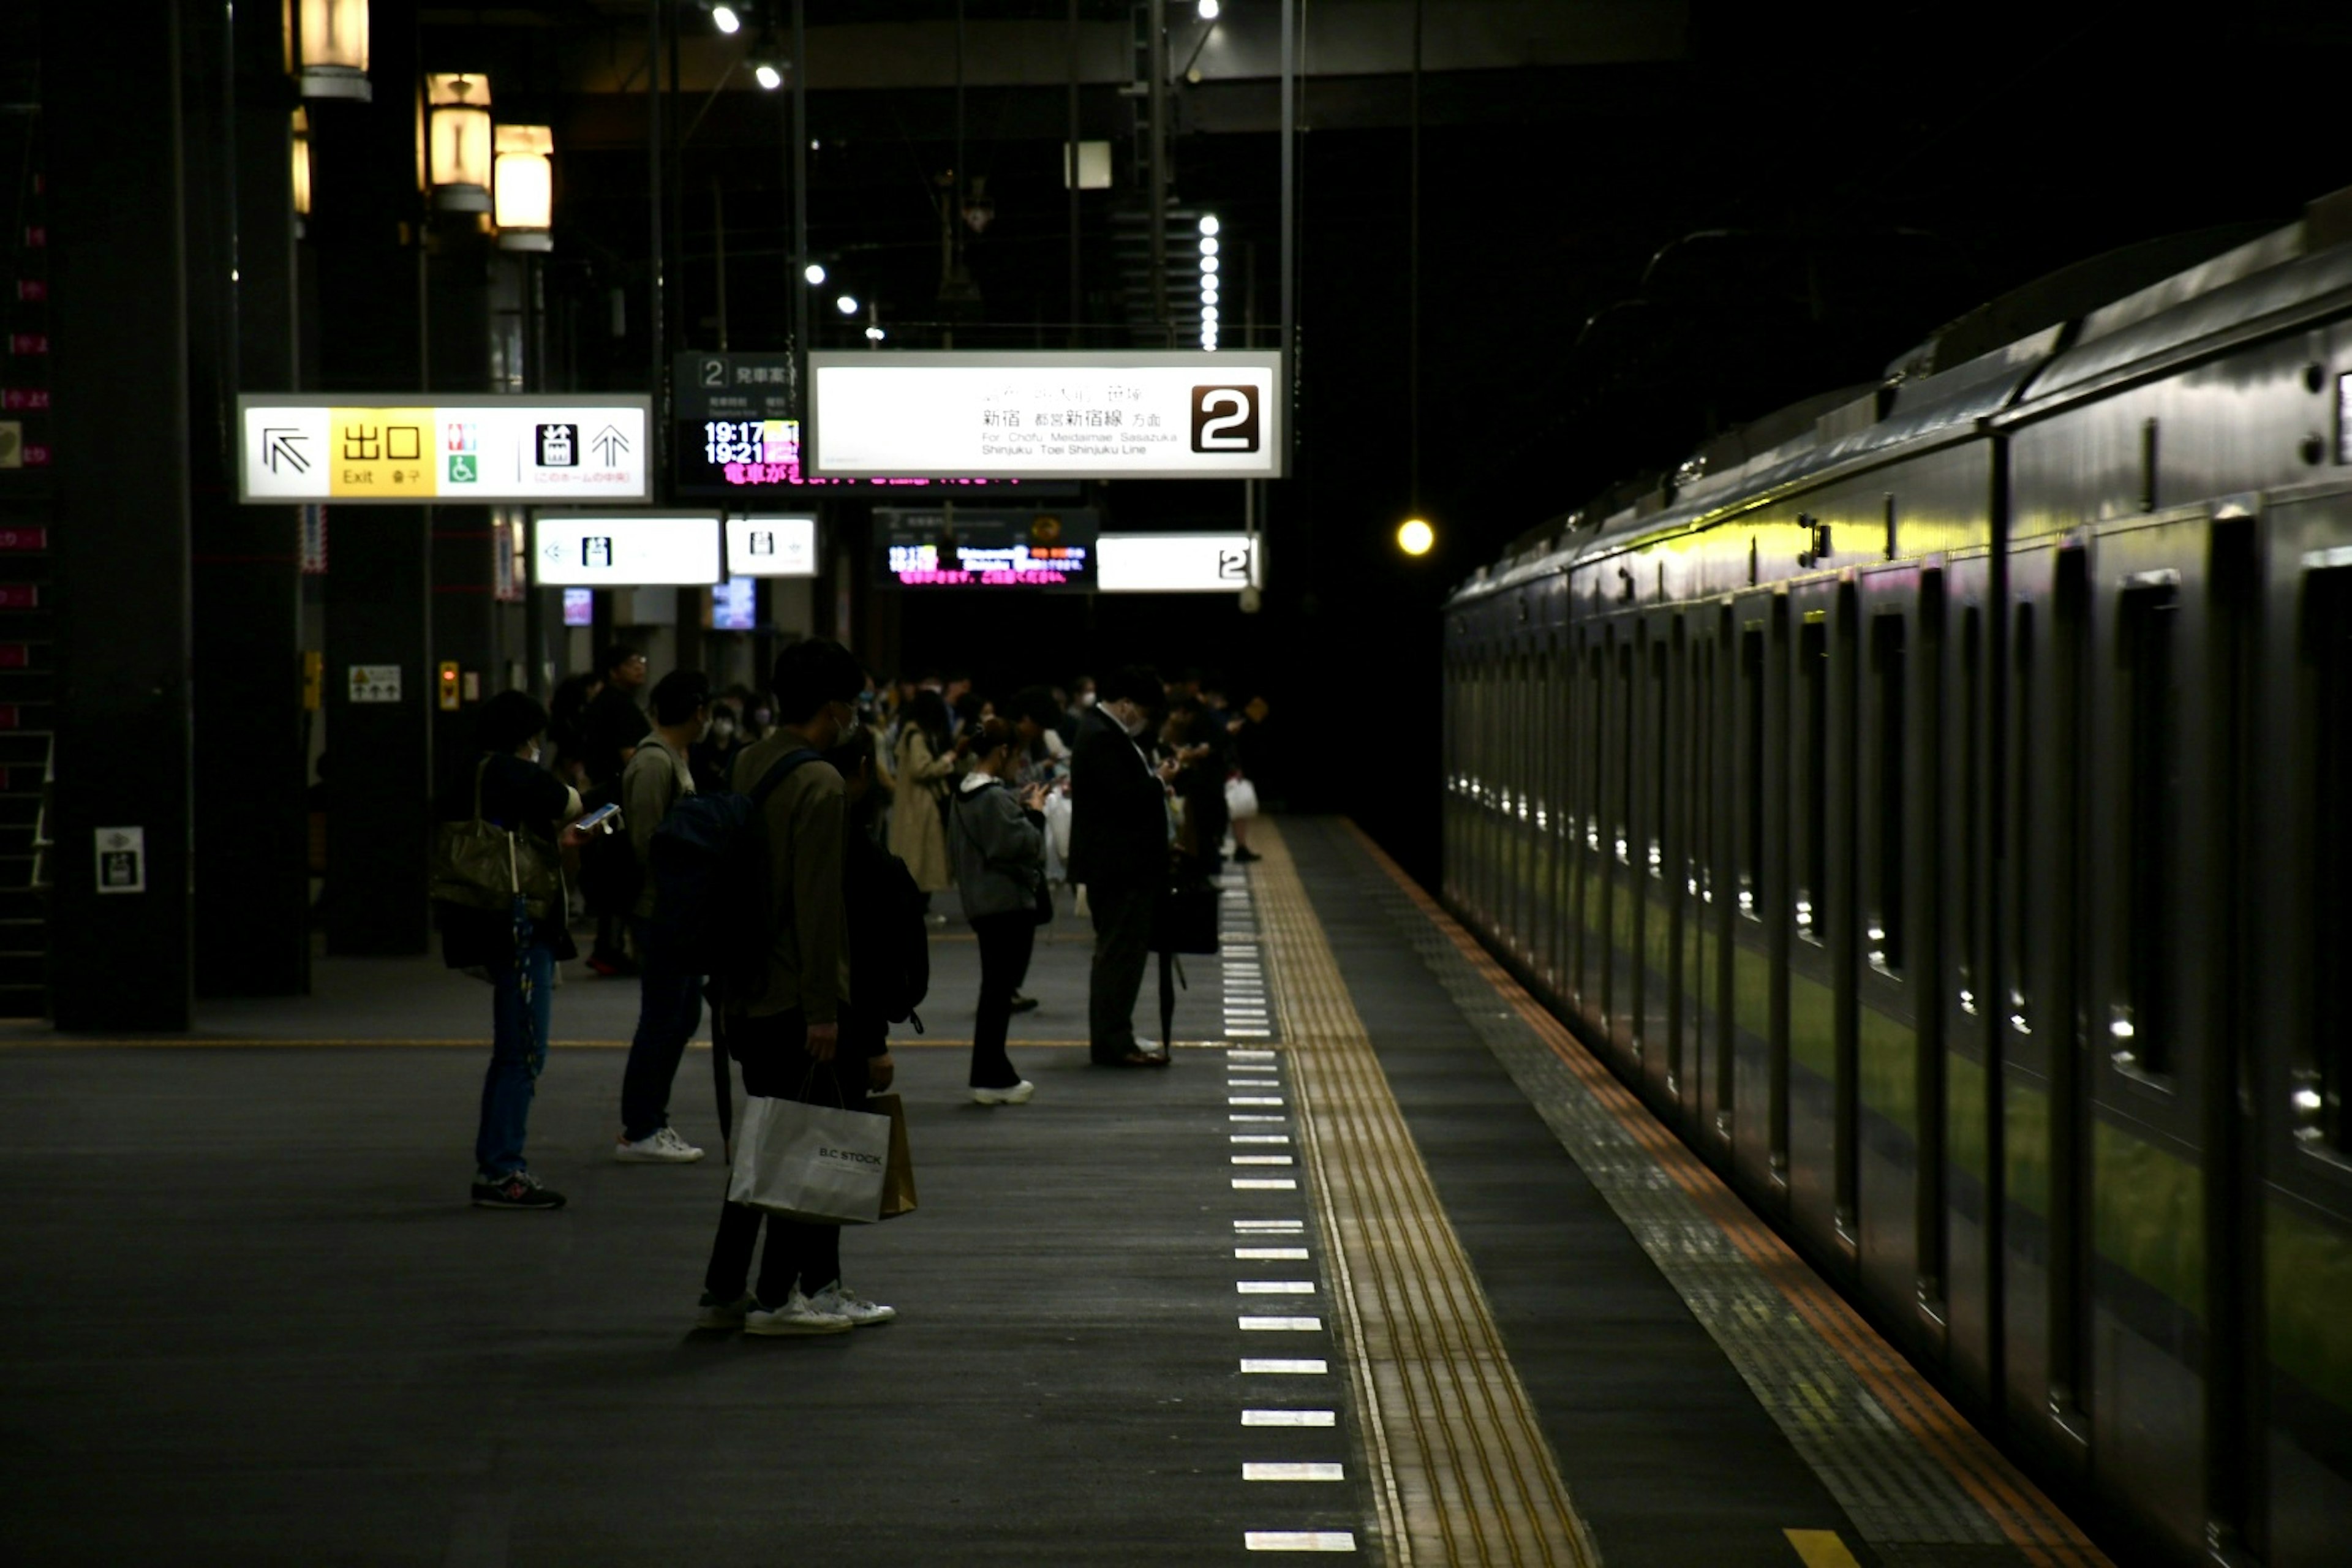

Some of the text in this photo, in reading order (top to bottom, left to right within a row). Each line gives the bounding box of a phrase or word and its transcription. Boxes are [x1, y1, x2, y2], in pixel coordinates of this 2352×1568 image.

[706, 360, 723, 386] 2
[983, 409, 1020, 428] 新宿
[1132, 413, 1161, 428] 方面
[1201, 388, 1250, 448] 2
[344, 423, 420, 460] 出口
[704, 421, 764, 443] 19:17
[982, 432, 1000, 442] For
[1120, 432, 1178, 442] Sasazuka
[704, 442, 763, 464] 19:21
[982, 444, 1147, 456] Shinjuku Toei Shinjuku Line
[343, 469, 374, 484] Exit
[1221, 549, 1247, 579] 2
[819, 1147, 882, 1165] B.C STOCK
